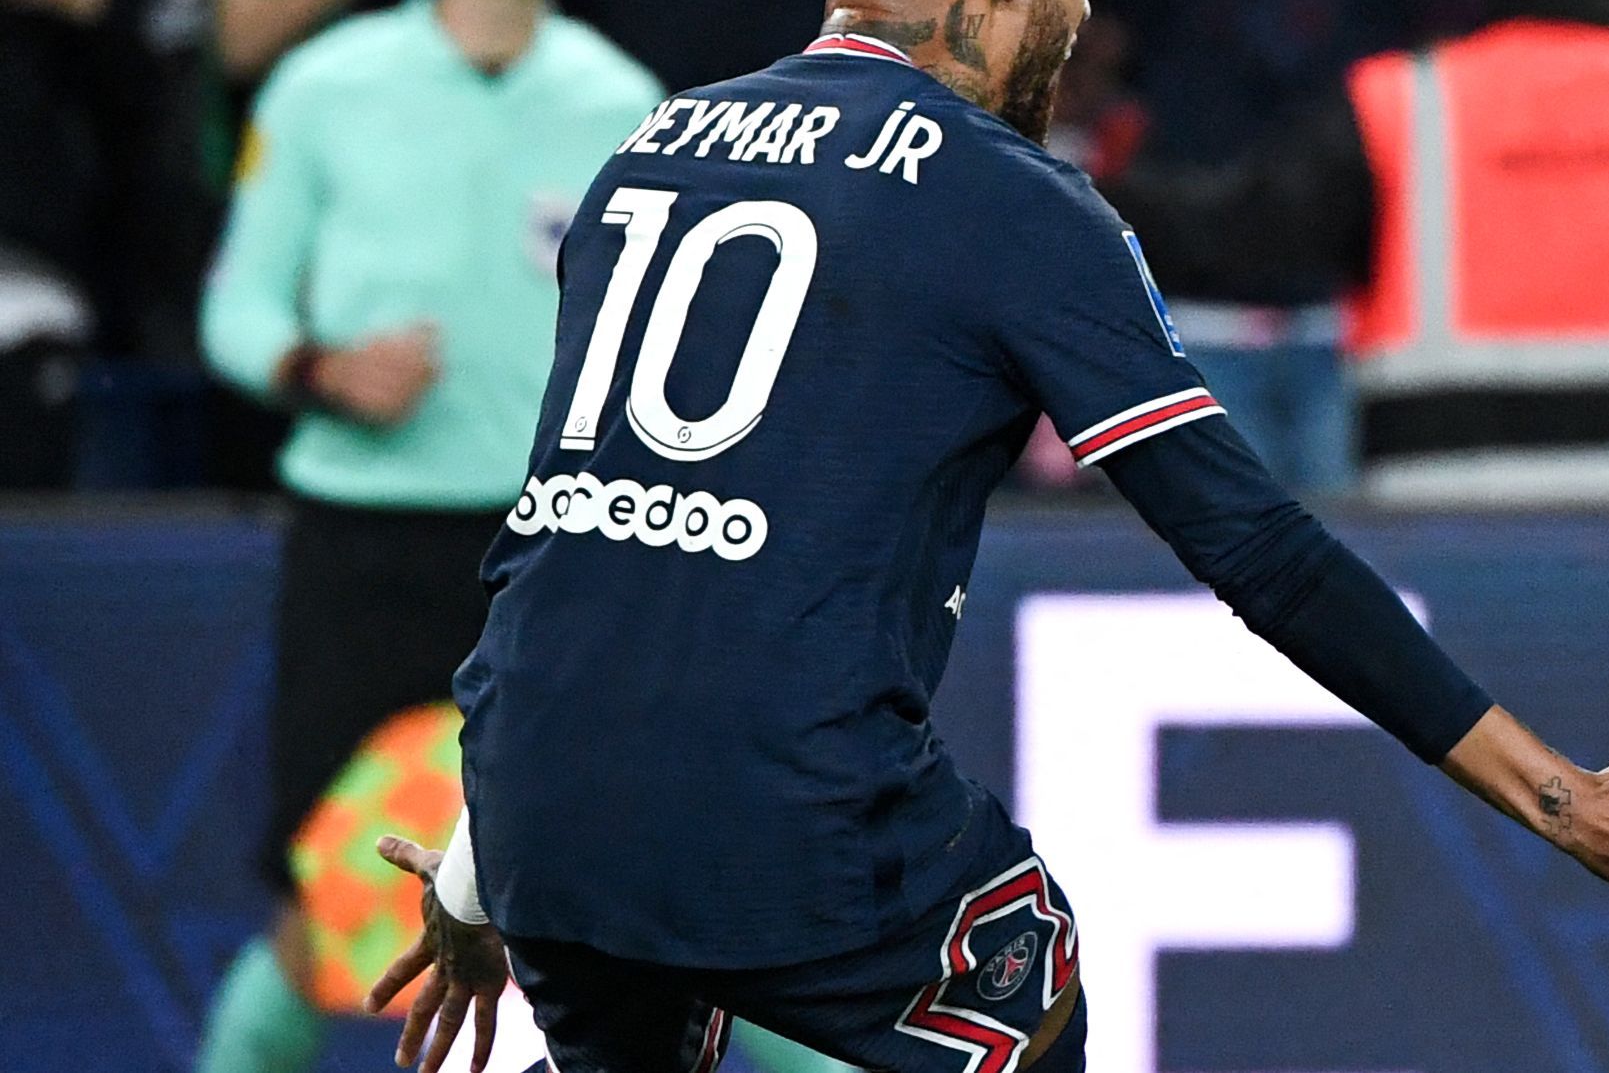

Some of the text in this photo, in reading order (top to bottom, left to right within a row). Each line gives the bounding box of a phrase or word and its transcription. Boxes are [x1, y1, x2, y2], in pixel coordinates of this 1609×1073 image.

[616, 98, 841, 165] NEYMAR
[560, 187, 818, 462] 10
[506, 471, 768, 561] ooredoo
